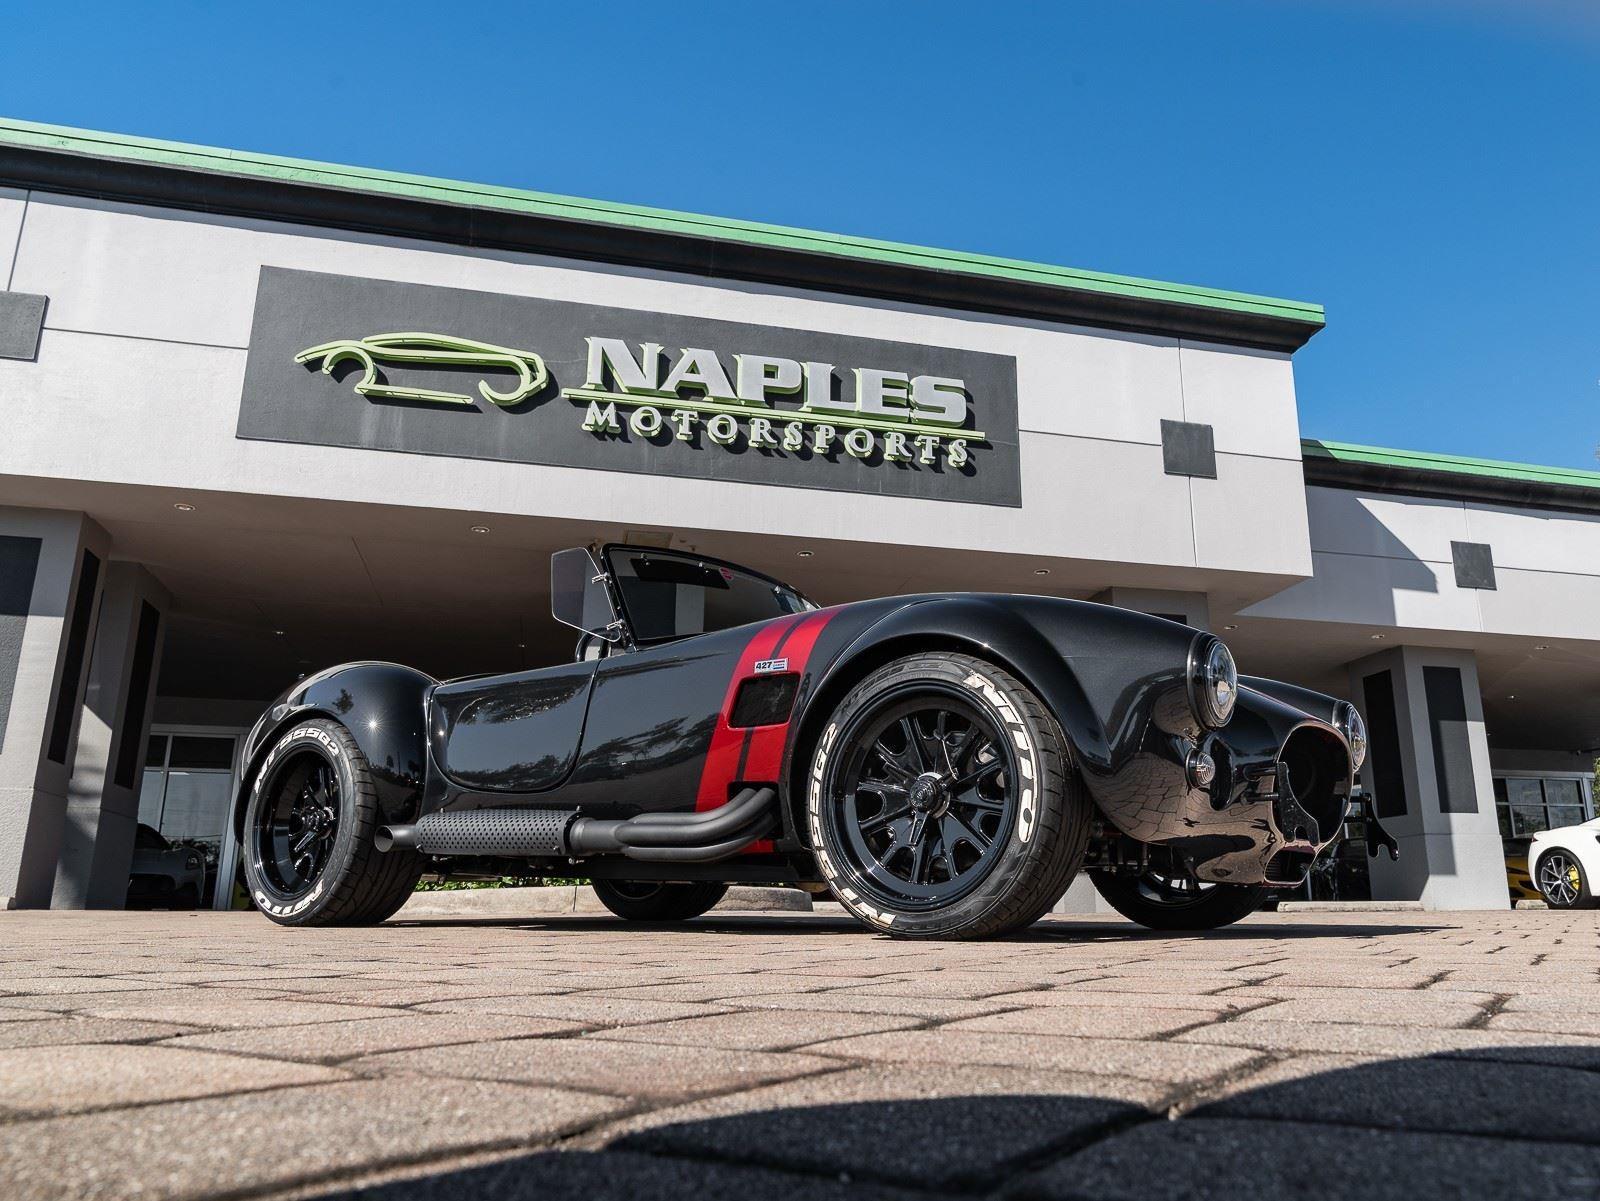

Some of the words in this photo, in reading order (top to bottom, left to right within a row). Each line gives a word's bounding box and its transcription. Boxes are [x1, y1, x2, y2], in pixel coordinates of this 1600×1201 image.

[584, 336, 968, 428] NAPLES
[581, 399, 972, 468] MOTORSPORTS
[755, 661, 773, 670] 427
[962, 669, 1039, 844] NITTO
